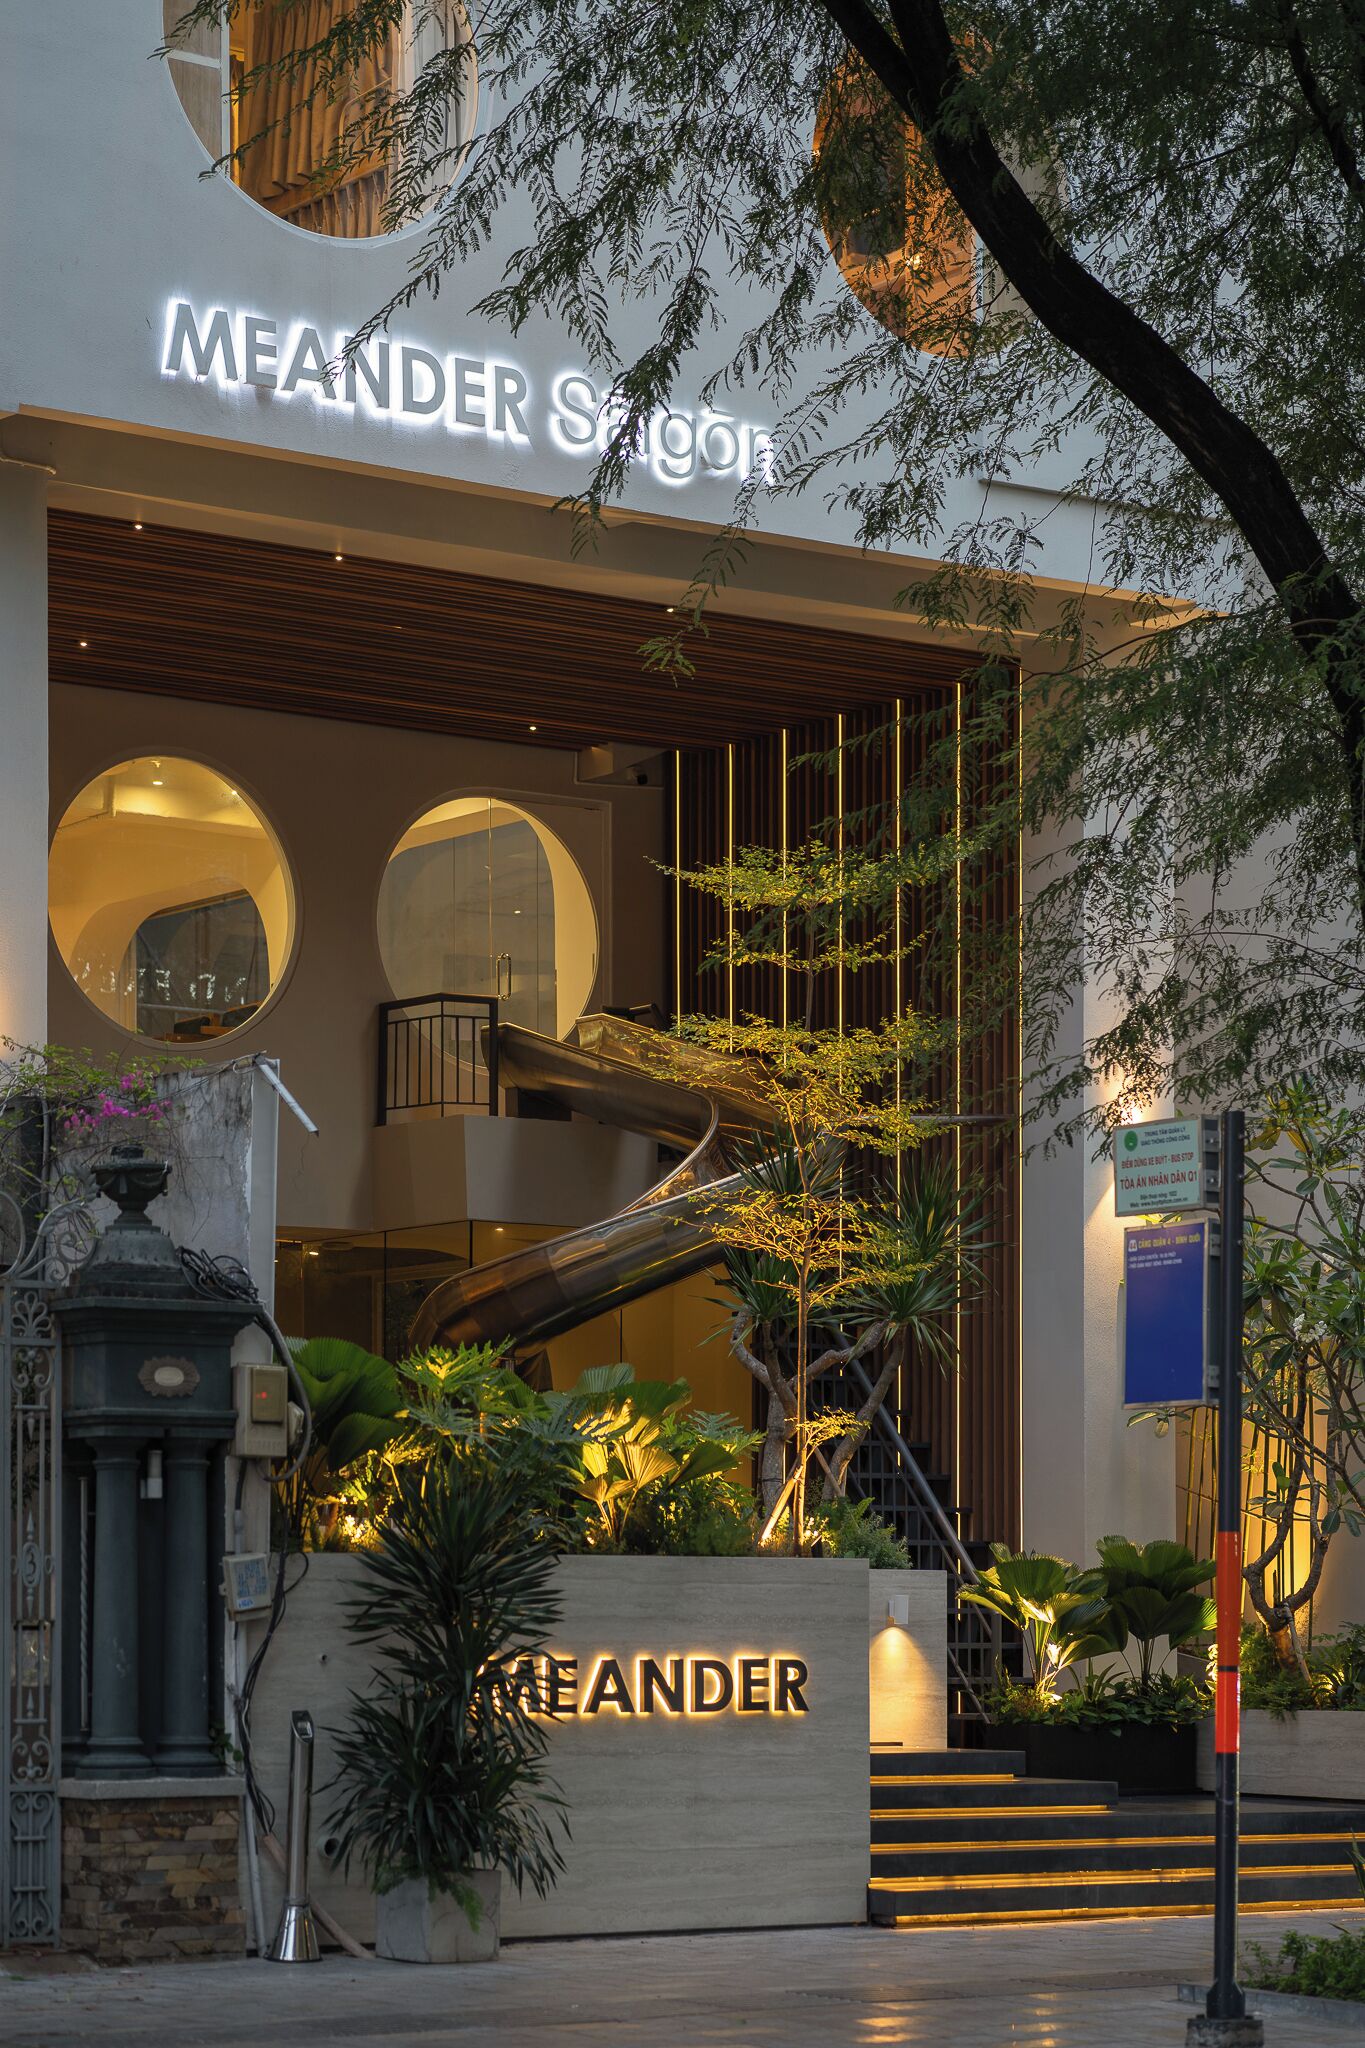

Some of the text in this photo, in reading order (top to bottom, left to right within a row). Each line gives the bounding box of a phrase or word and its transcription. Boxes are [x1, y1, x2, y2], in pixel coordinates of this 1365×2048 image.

[165, 303, 531, 436] MEANDER
[1148, 1157, 1154, 1166] XE
[1171, 1153, 1181, 1163] BUS
[1181, 1151, 1194, 1161] STOP
[1136, 1173, 1147, 1188] ÁN
[1148, 1171, 1169, 1187] NHÂN
[1170, 1169, 1186, 1184] DÂN
